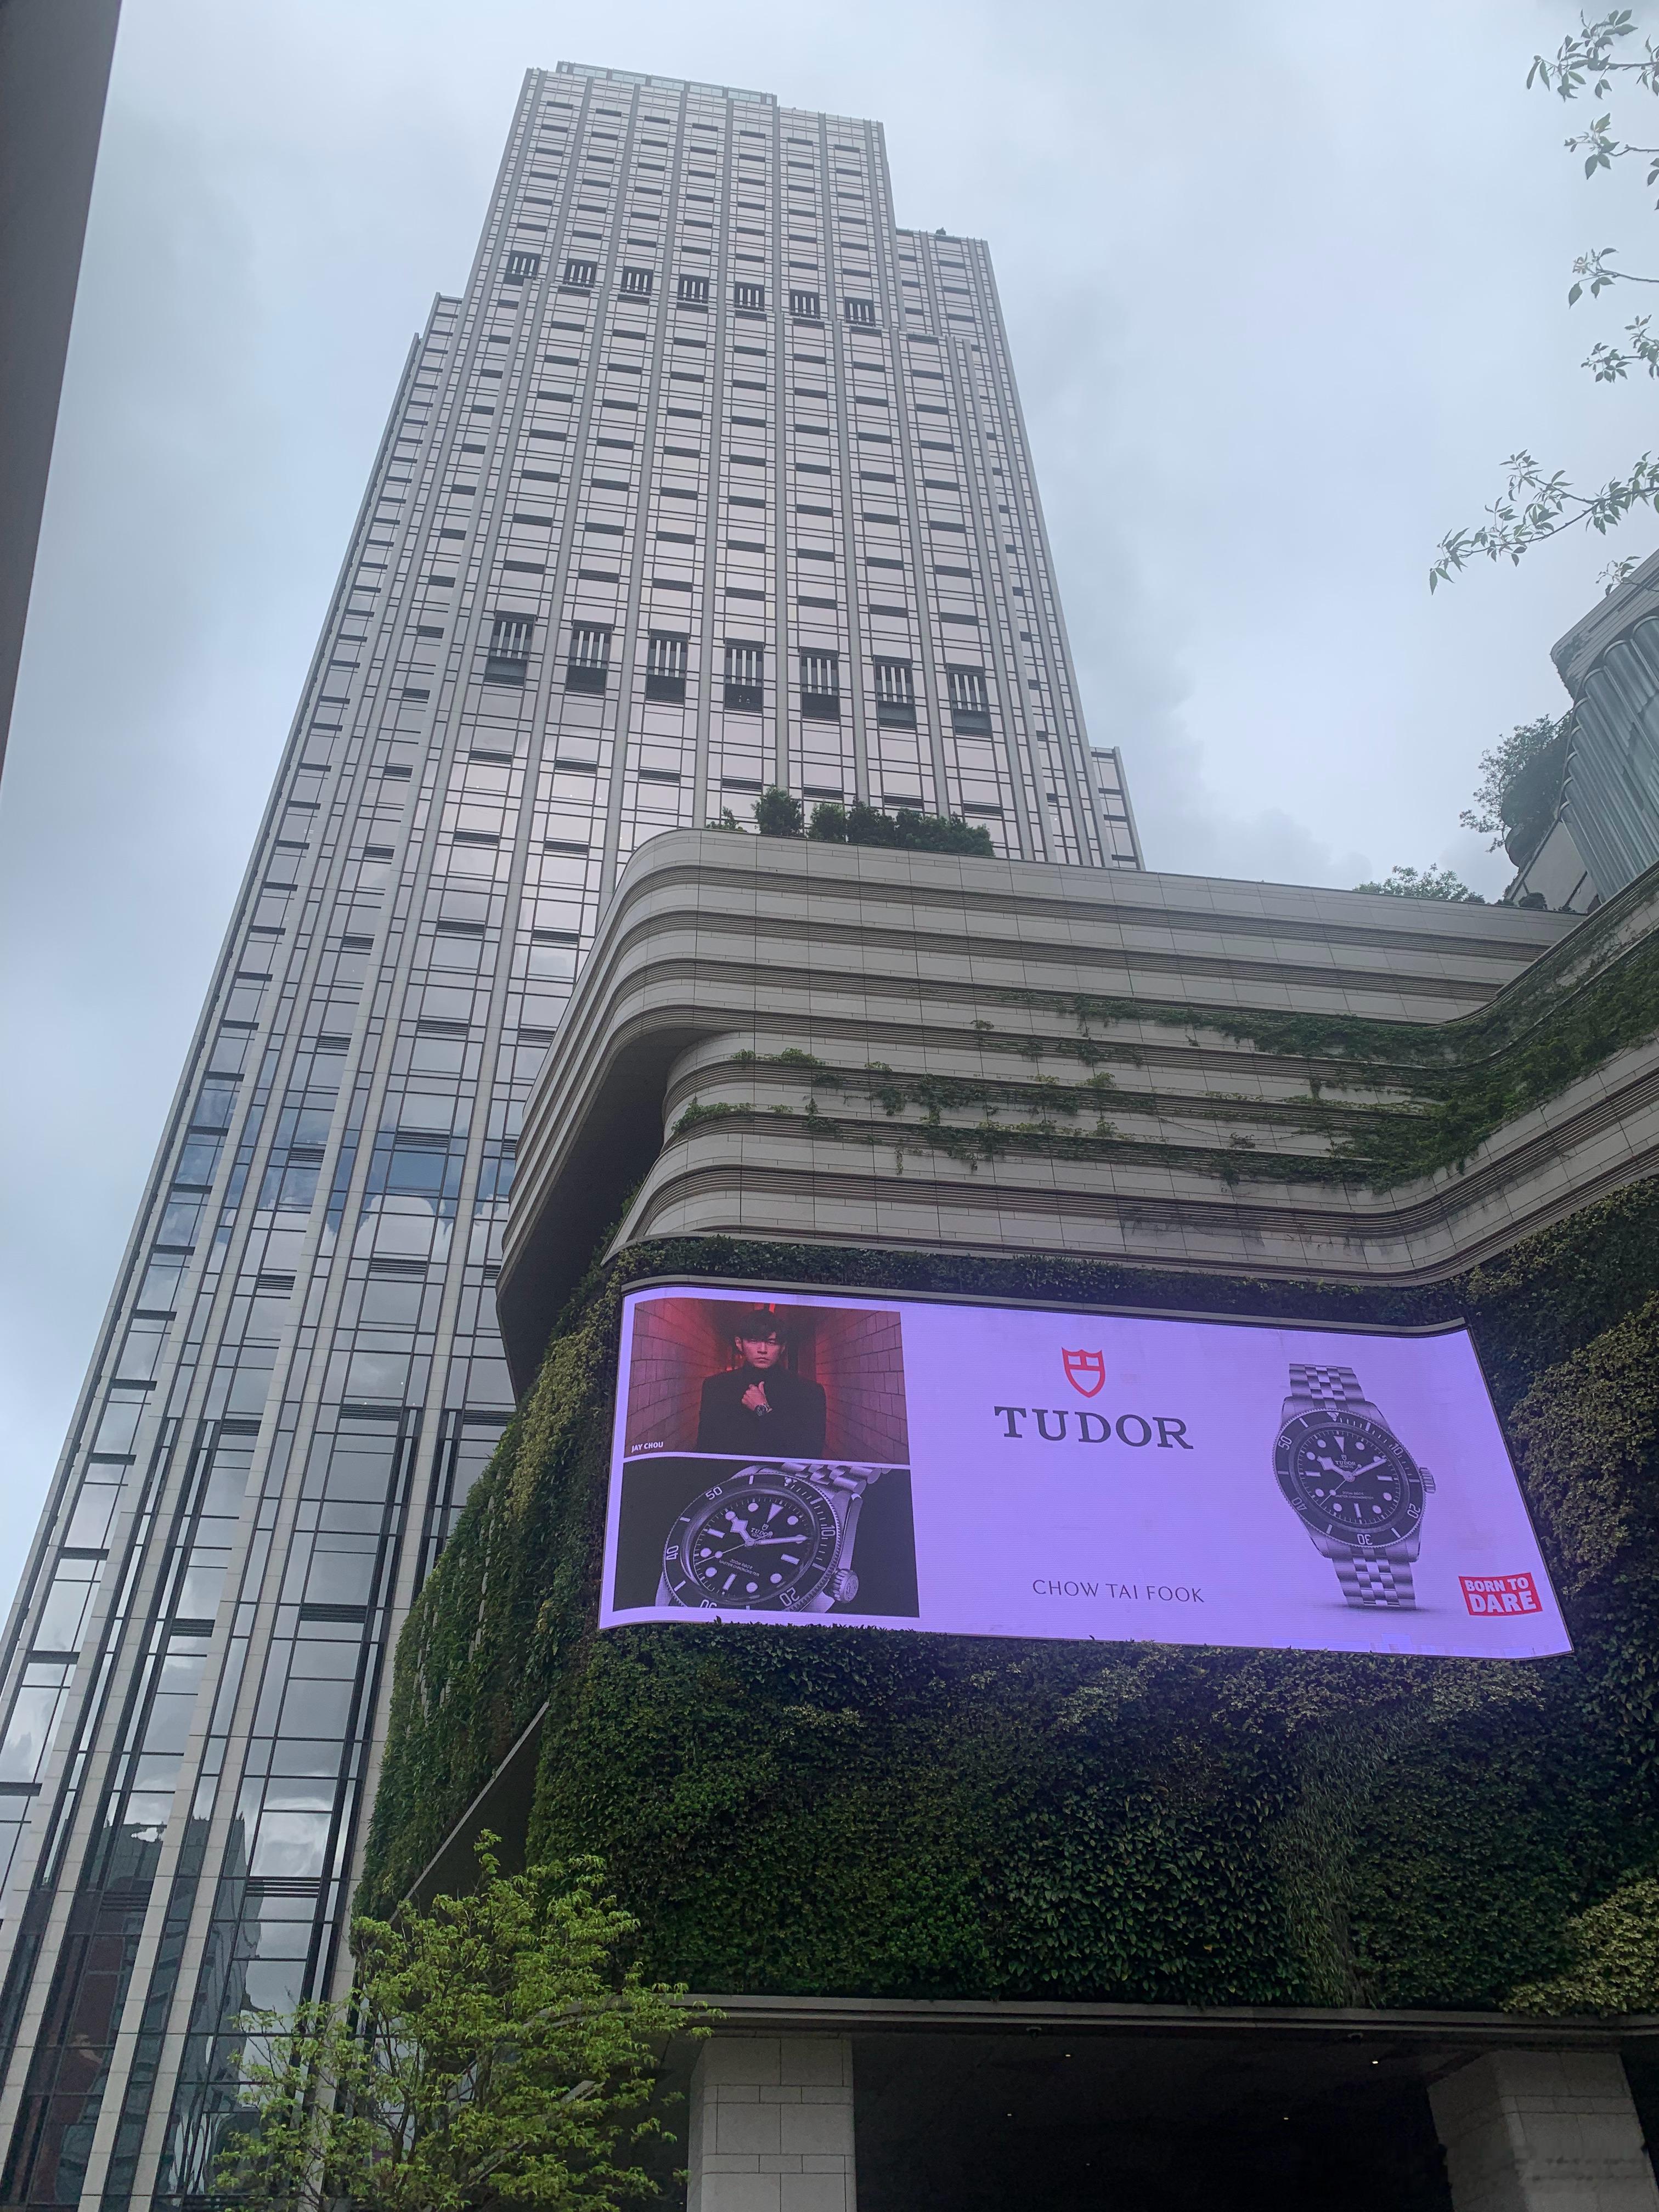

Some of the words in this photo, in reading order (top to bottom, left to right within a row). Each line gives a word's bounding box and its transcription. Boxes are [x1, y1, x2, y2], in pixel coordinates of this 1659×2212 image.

[994, 1406, 1194, 1449] TUDOR
[631, 1443, 643, 1453] JAY
[644, 1441, 663, 1449] CHOU
[1278, 1435, 1293, 1451] 50
[1391, 1442, 1404, 1456] 10
[705, 1486, 723, 1500] 50
[1407, 1503, 1421, 1519] 20
[751, 1527, 771, 1538] TUDO
[821, 1525, 836, 1537] 10
[1357, 1533, 1373, 1545] 30
[665, 1544, 679, 1561] 40
[1032, 1579, 1099, 1598] CHOW
[1105, 1583, 1138, 1600] TAI
[1146, 1585, 1205, 1602] FOOK
[1464, 1579, 1506, 1592] BORN
[1507, 1577, 1530, 1590] TO
[779, 1587, 800, 1607] 20
[1468, 1590, 1537, 1613] DARE
